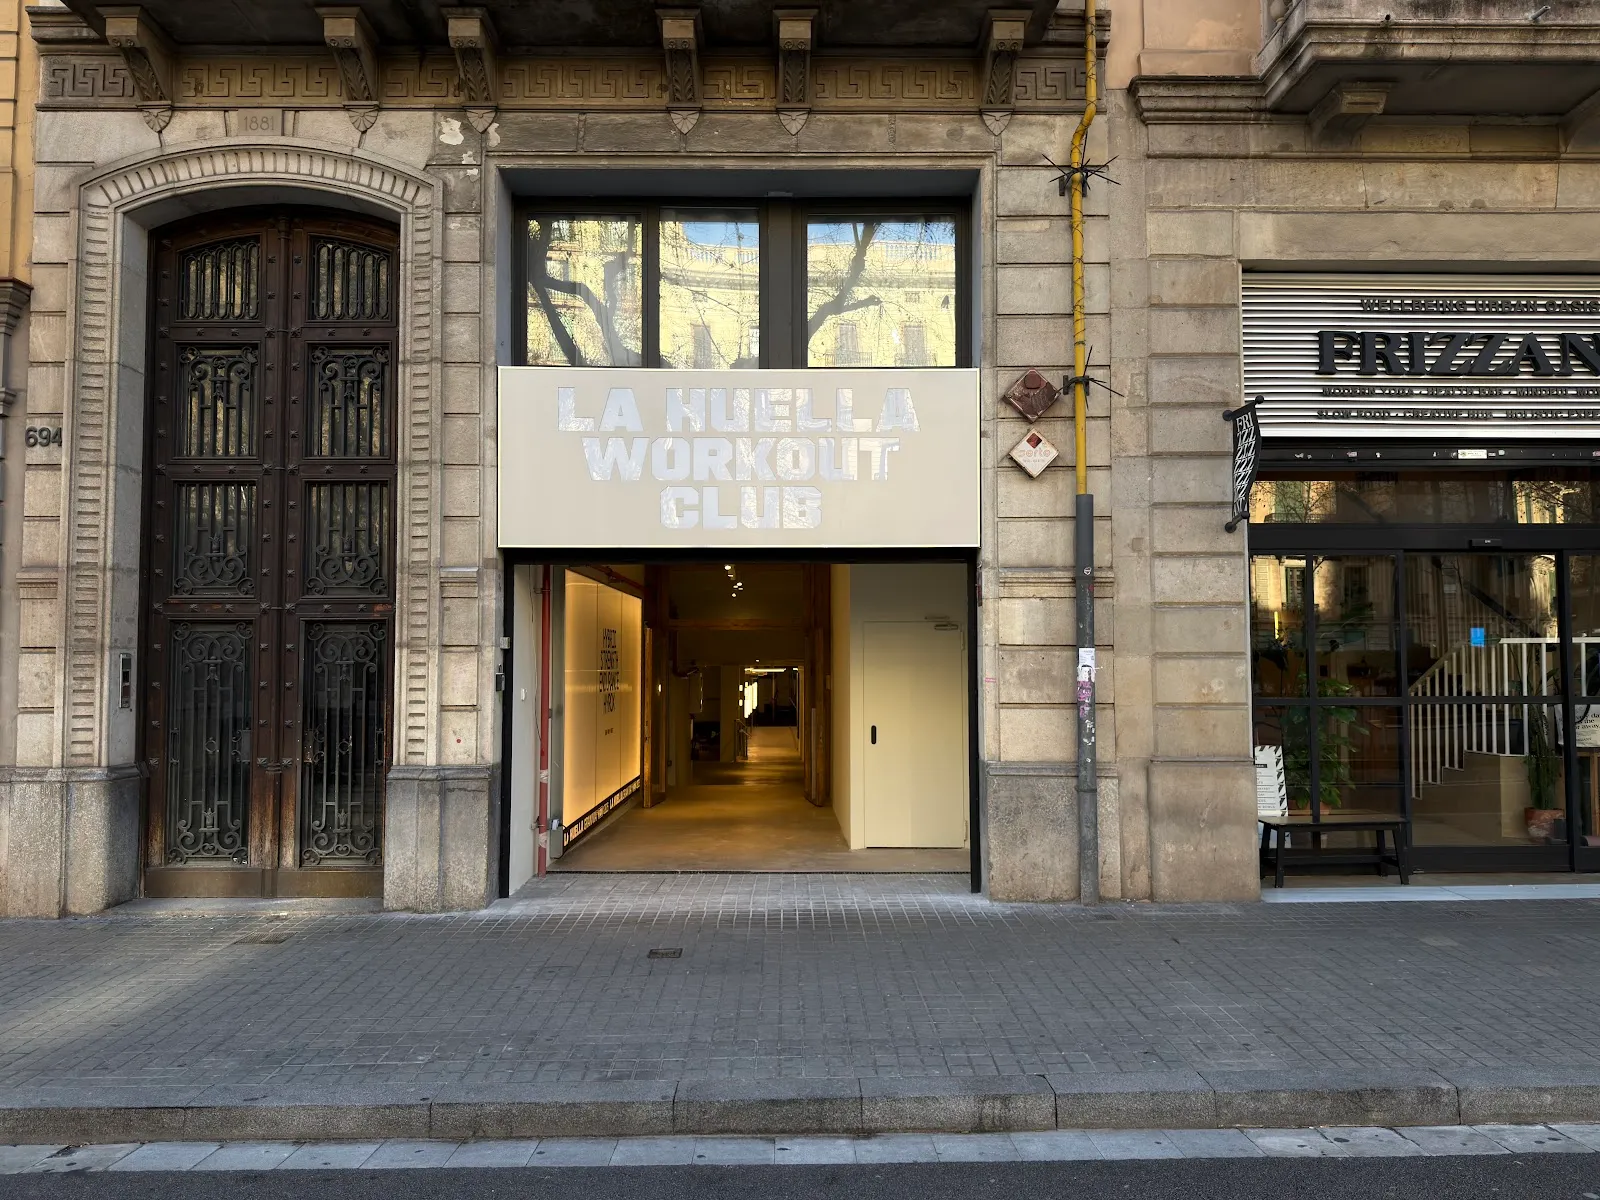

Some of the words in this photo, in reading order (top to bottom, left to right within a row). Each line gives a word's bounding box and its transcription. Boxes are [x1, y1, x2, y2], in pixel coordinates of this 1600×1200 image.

[243, 115, 274, 132] 1881
[1361, 299, 1467, 313] WELLBEING
[1475, 300, 1538, 313] URBAN
[1545, 300, 1600, 313] OASIS
[1322, 386, 1375, 397] MODERN
[557, 387, 644, 432] LA
[665, 387, 921, 433] HUELLA
[1316, 409, 1351, 419] SLOW
[1357, 409, 1391, 419] FOOD
[1403, 409, 1464, 420] CREATIVE
[1236, 411, 1254, 434] FRI
[25, 425, 62, 448] 694
[580, 436, 901, 481] WORKOUT
[659, 485, 823, 530] CLUB
